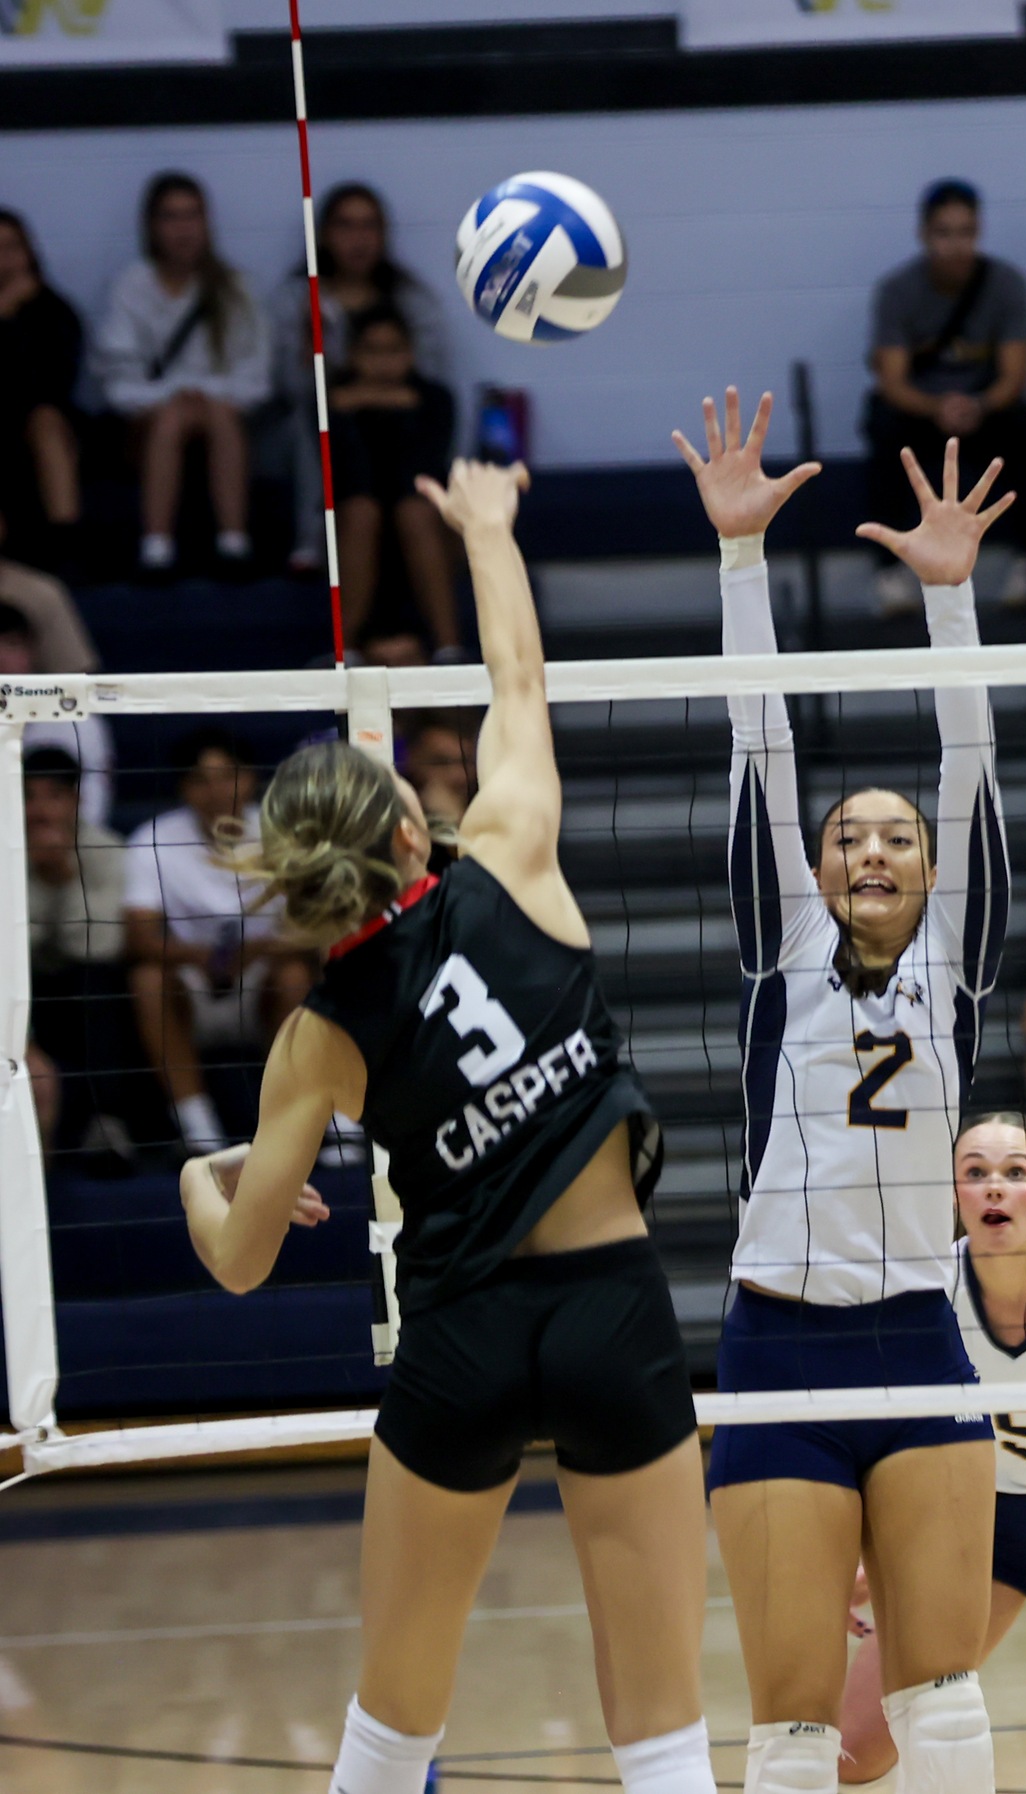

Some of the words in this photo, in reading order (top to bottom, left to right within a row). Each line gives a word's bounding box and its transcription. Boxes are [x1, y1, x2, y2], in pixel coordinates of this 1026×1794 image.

[14, 685, 64, 697] Senoh
[418, 952, 526, 1087] 3
[435, 1028, 599, 1171] CASPER
[847, 1029, 914, 1131] 2
